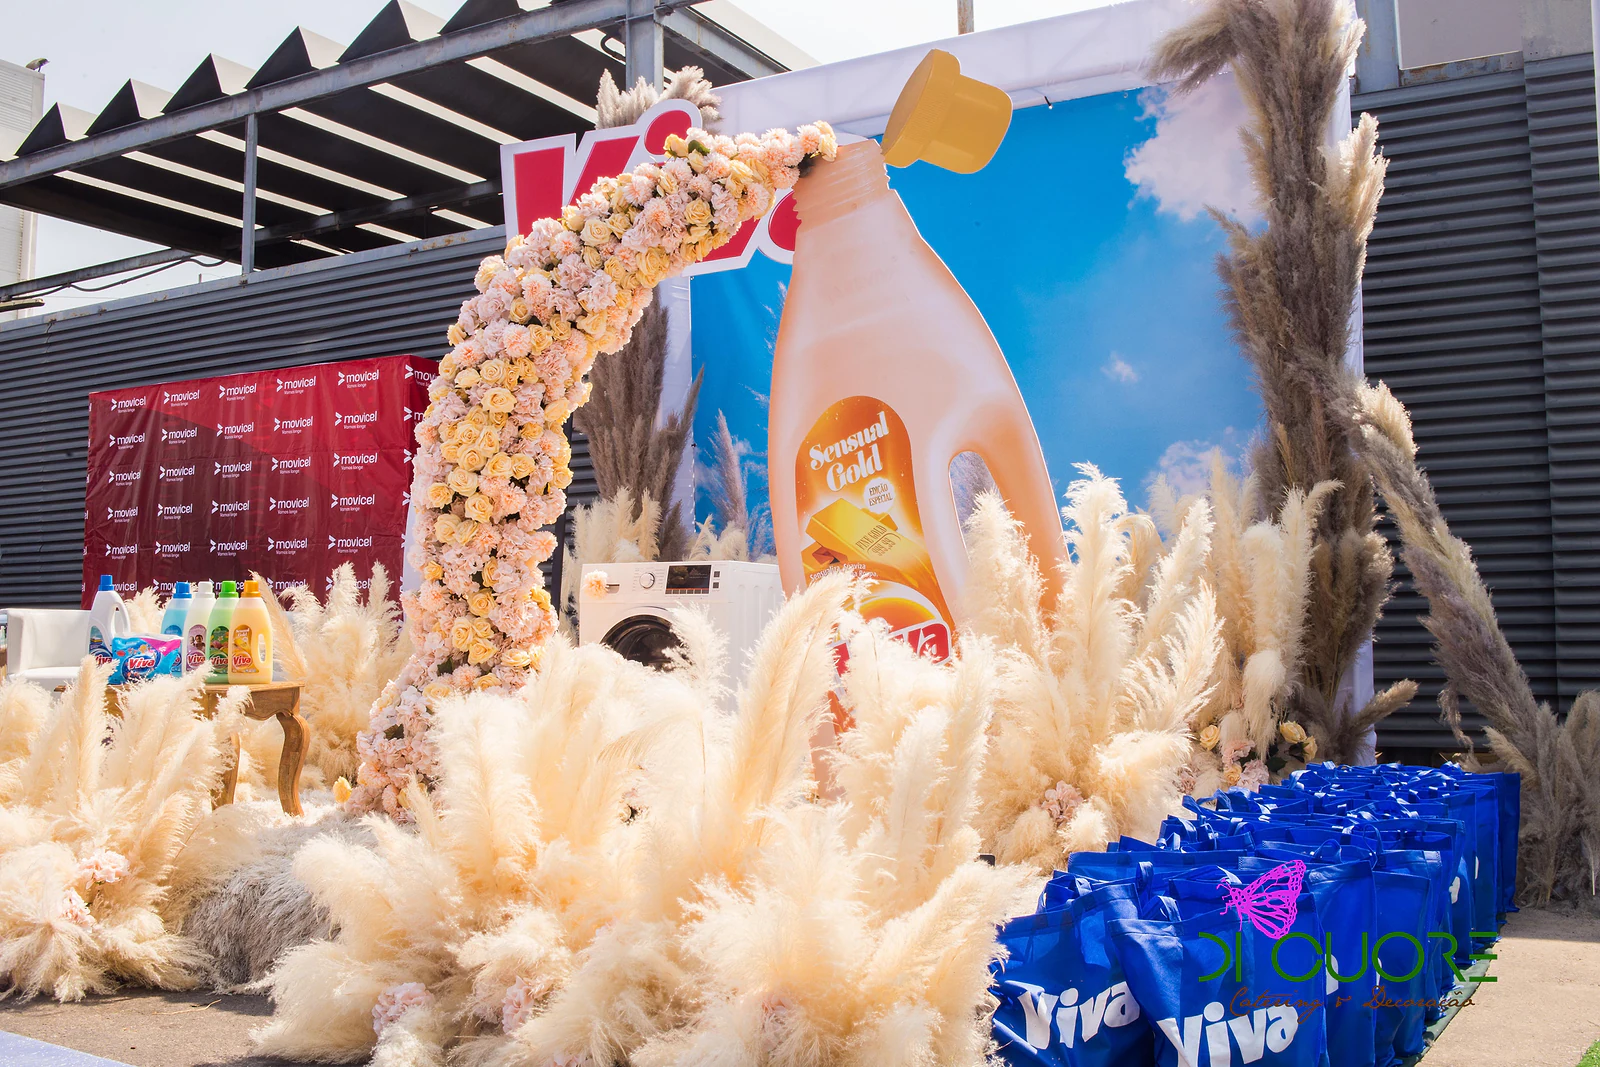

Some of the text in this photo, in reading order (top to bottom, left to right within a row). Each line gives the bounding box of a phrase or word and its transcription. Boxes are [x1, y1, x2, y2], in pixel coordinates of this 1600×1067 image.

[284, 376, 316, 389] movicel
[346, 370, 379, 383] movicel
[226, 383, 256, 395] movicel
[171, 390, 200, 402] movicel
[282, 416, 313, 428] movicel
[344, 411, 377, 423] movicel
[169, 427, 197, 439] movicel
[225, 422, 254, 434] movicel
[809, 411, 889, 470] Sensual
[280, 457, 311, 468] movicel
[341, 453, 378, 464] movicel
[166, 465, 195, 476] movicel
[222, 461, 252, 473] movicel
[826, 444, 882, 492] Gold
[220, 500, 250, 511] movicel
[278, 497, 310, 508] movicel
[340, 494, 375, 505] movicel
[869, 493, 893, 506] ESPECIAL
[164, 504, 192, 514] movicel
[276, 538, 308, 549] movicel
[338, 536, 372, 547] movicel
[856, 525, 887, 550] FINE GOLD
[162, 542, 190, 552] movicel
[218, 540, 248, 550] movicel
[128, 657, 155, 669] Viva
[188, 654, 205, 663] Viva
[211, 657, 228, 665] Viva
[233, 656, 251, 665] Viva
[1017, 981, 1141, 1050] Viva
[1156, 1001, 1299, 1067] Viva
